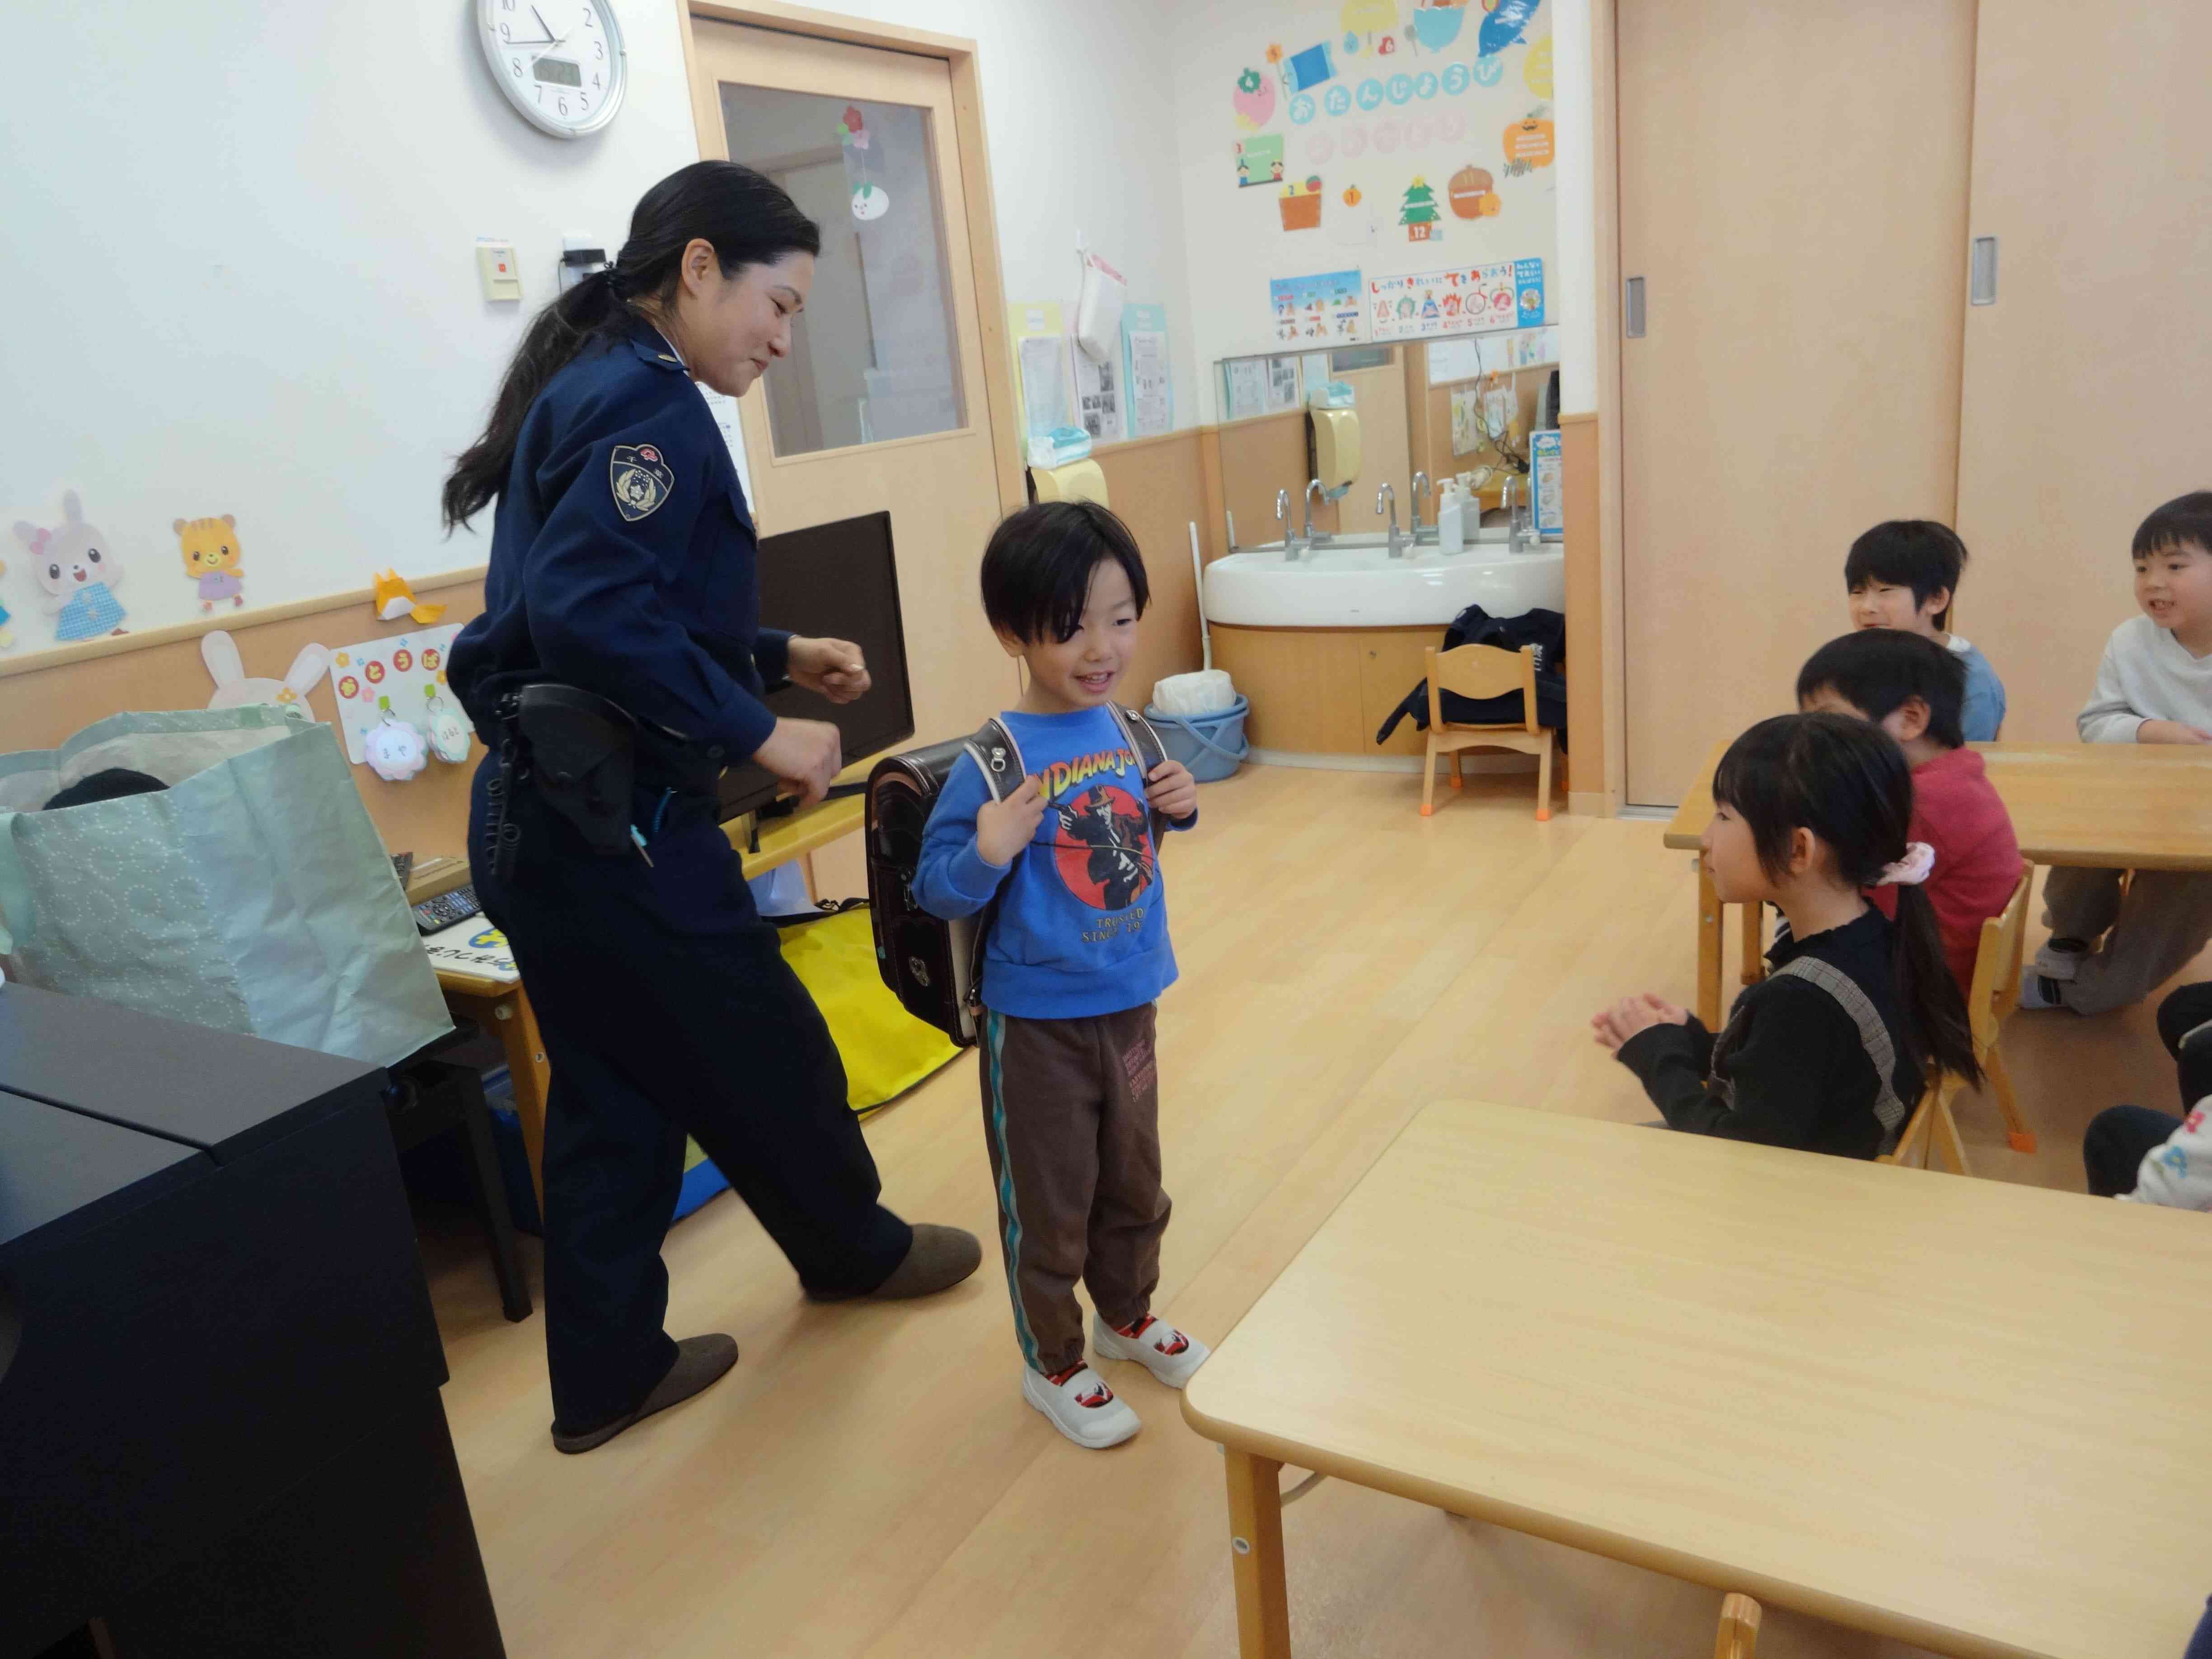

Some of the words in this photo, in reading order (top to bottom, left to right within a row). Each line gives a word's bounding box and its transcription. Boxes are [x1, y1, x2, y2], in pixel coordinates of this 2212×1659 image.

[583, 7, 593, 27] 2
[500, 23, 511, 43] 9
[594, 41, 604, 60] 3
[512, 57, 523, 77] 8
[592, 72, 601, 90] 4
[1245, 76, 1254, 88] 4
[1293, 58, 1501, 120] おたんじょうび
[534, 84, 542, 103] 7
[580, 92, 589, 110] 5
[558, 97, 568, 116] 6
[1349, 191, 1354, 204] 1
[1414, 226, 1426, 239] 12
[1032, 750, 1115, 799] NDIANA
